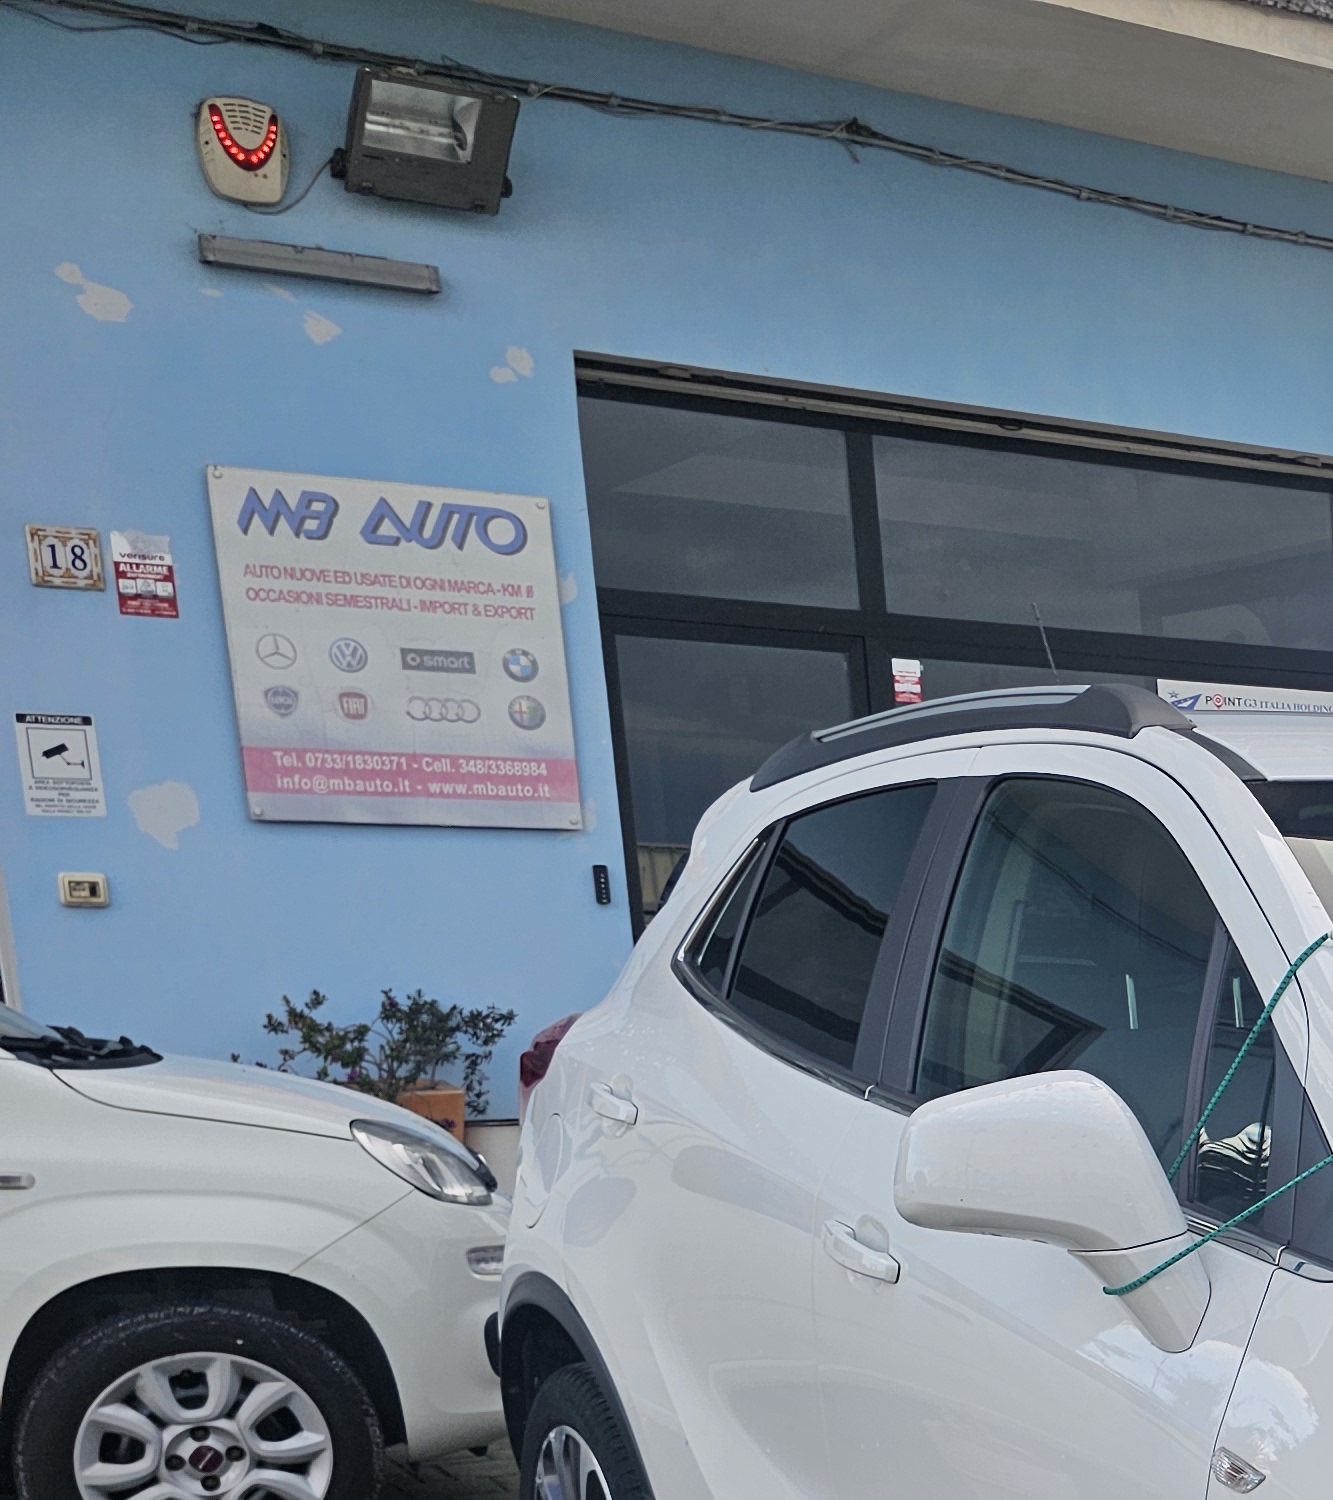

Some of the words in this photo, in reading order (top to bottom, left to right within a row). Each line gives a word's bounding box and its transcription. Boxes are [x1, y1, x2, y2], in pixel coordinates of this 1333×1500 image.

[237, 486, 340, 540] MB
[359, 496, 528, 556] AUTO
[46, 543, 88, 571] 18
[119, 562, 170, 575] ALLARME
[243, 563, 282, 580] AUTO
[283, 566, 333, 583] NUOVE
[333, 569, 352, 585] ED
[354, 571, 398, 589] USATE
[413, 576, 446, 592] OGNI
[447, 578, 496, 596] MARCA
[501, 583, 523, 598] KM
[245, 586, 324, 606] OCCASIONI
[325, 592, 411, 612] SEMESTRALI
[418, 599, 469, 616] IMPORT
[471, 603, 482, 617] &
[483, 604, 536, 621] EXPORT
[423, 655, 471, 669] smart
[1259, 701, 1291, 711] ITALIA
[25, 715, 83, 724] ATTENZIONE
[272, 751, 301, 768] Tel.
[305, 753, 407, 771] 0733/1830371
[422, 757, 456, 774] Cell.
[458, 759, 548, 777] 348/3368984
[275, 773, 411, 794] info@mbauto.it
[428, 781, 551, 798] www.mbauto.it
